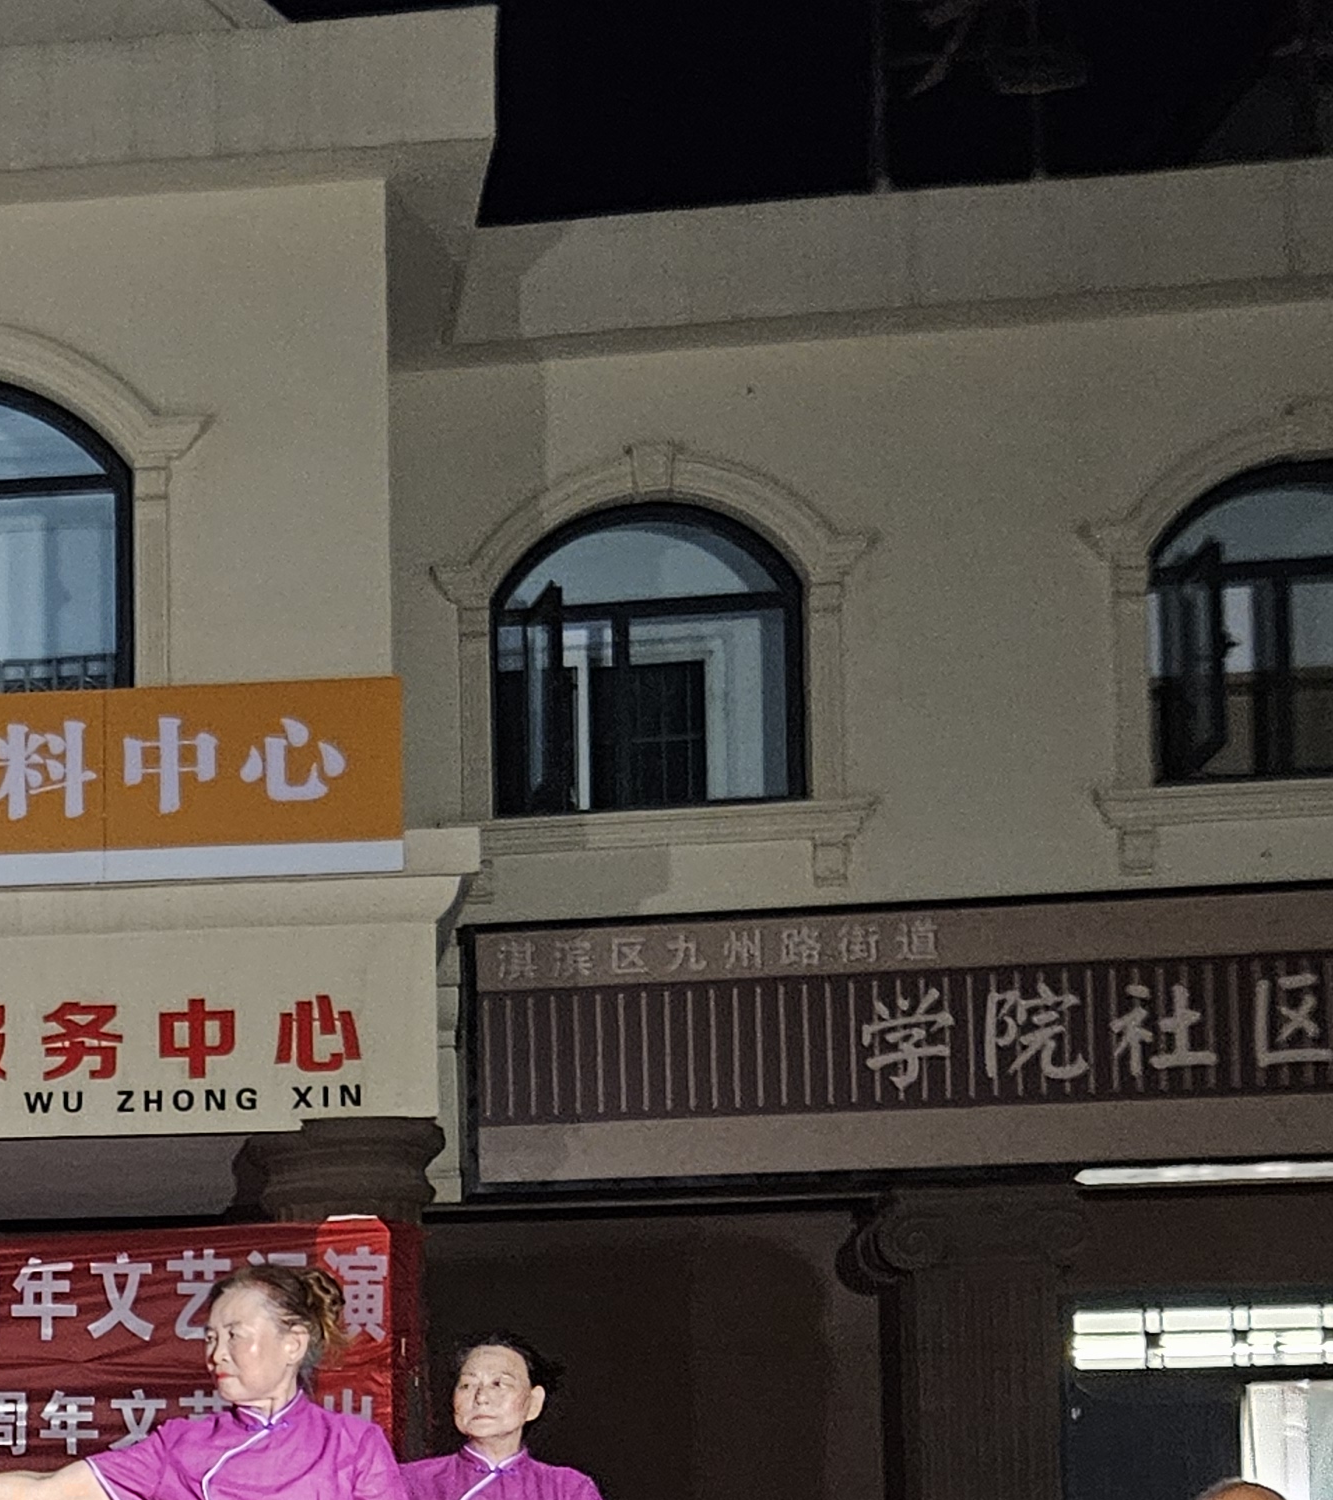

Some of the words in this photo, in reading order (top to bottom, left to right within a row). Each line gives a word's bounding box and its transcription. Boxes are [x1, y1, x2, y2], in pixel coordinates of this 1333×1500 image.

[496, 921, 940, 980] 淇滨区九州路街道
[861, 972, 1333, 1092] 学院社区
[24, 1091, 85, 1114] WU
[117, 1088, 259, 1113] ZHONG
[292, 1084, 363, 1110] XIN
